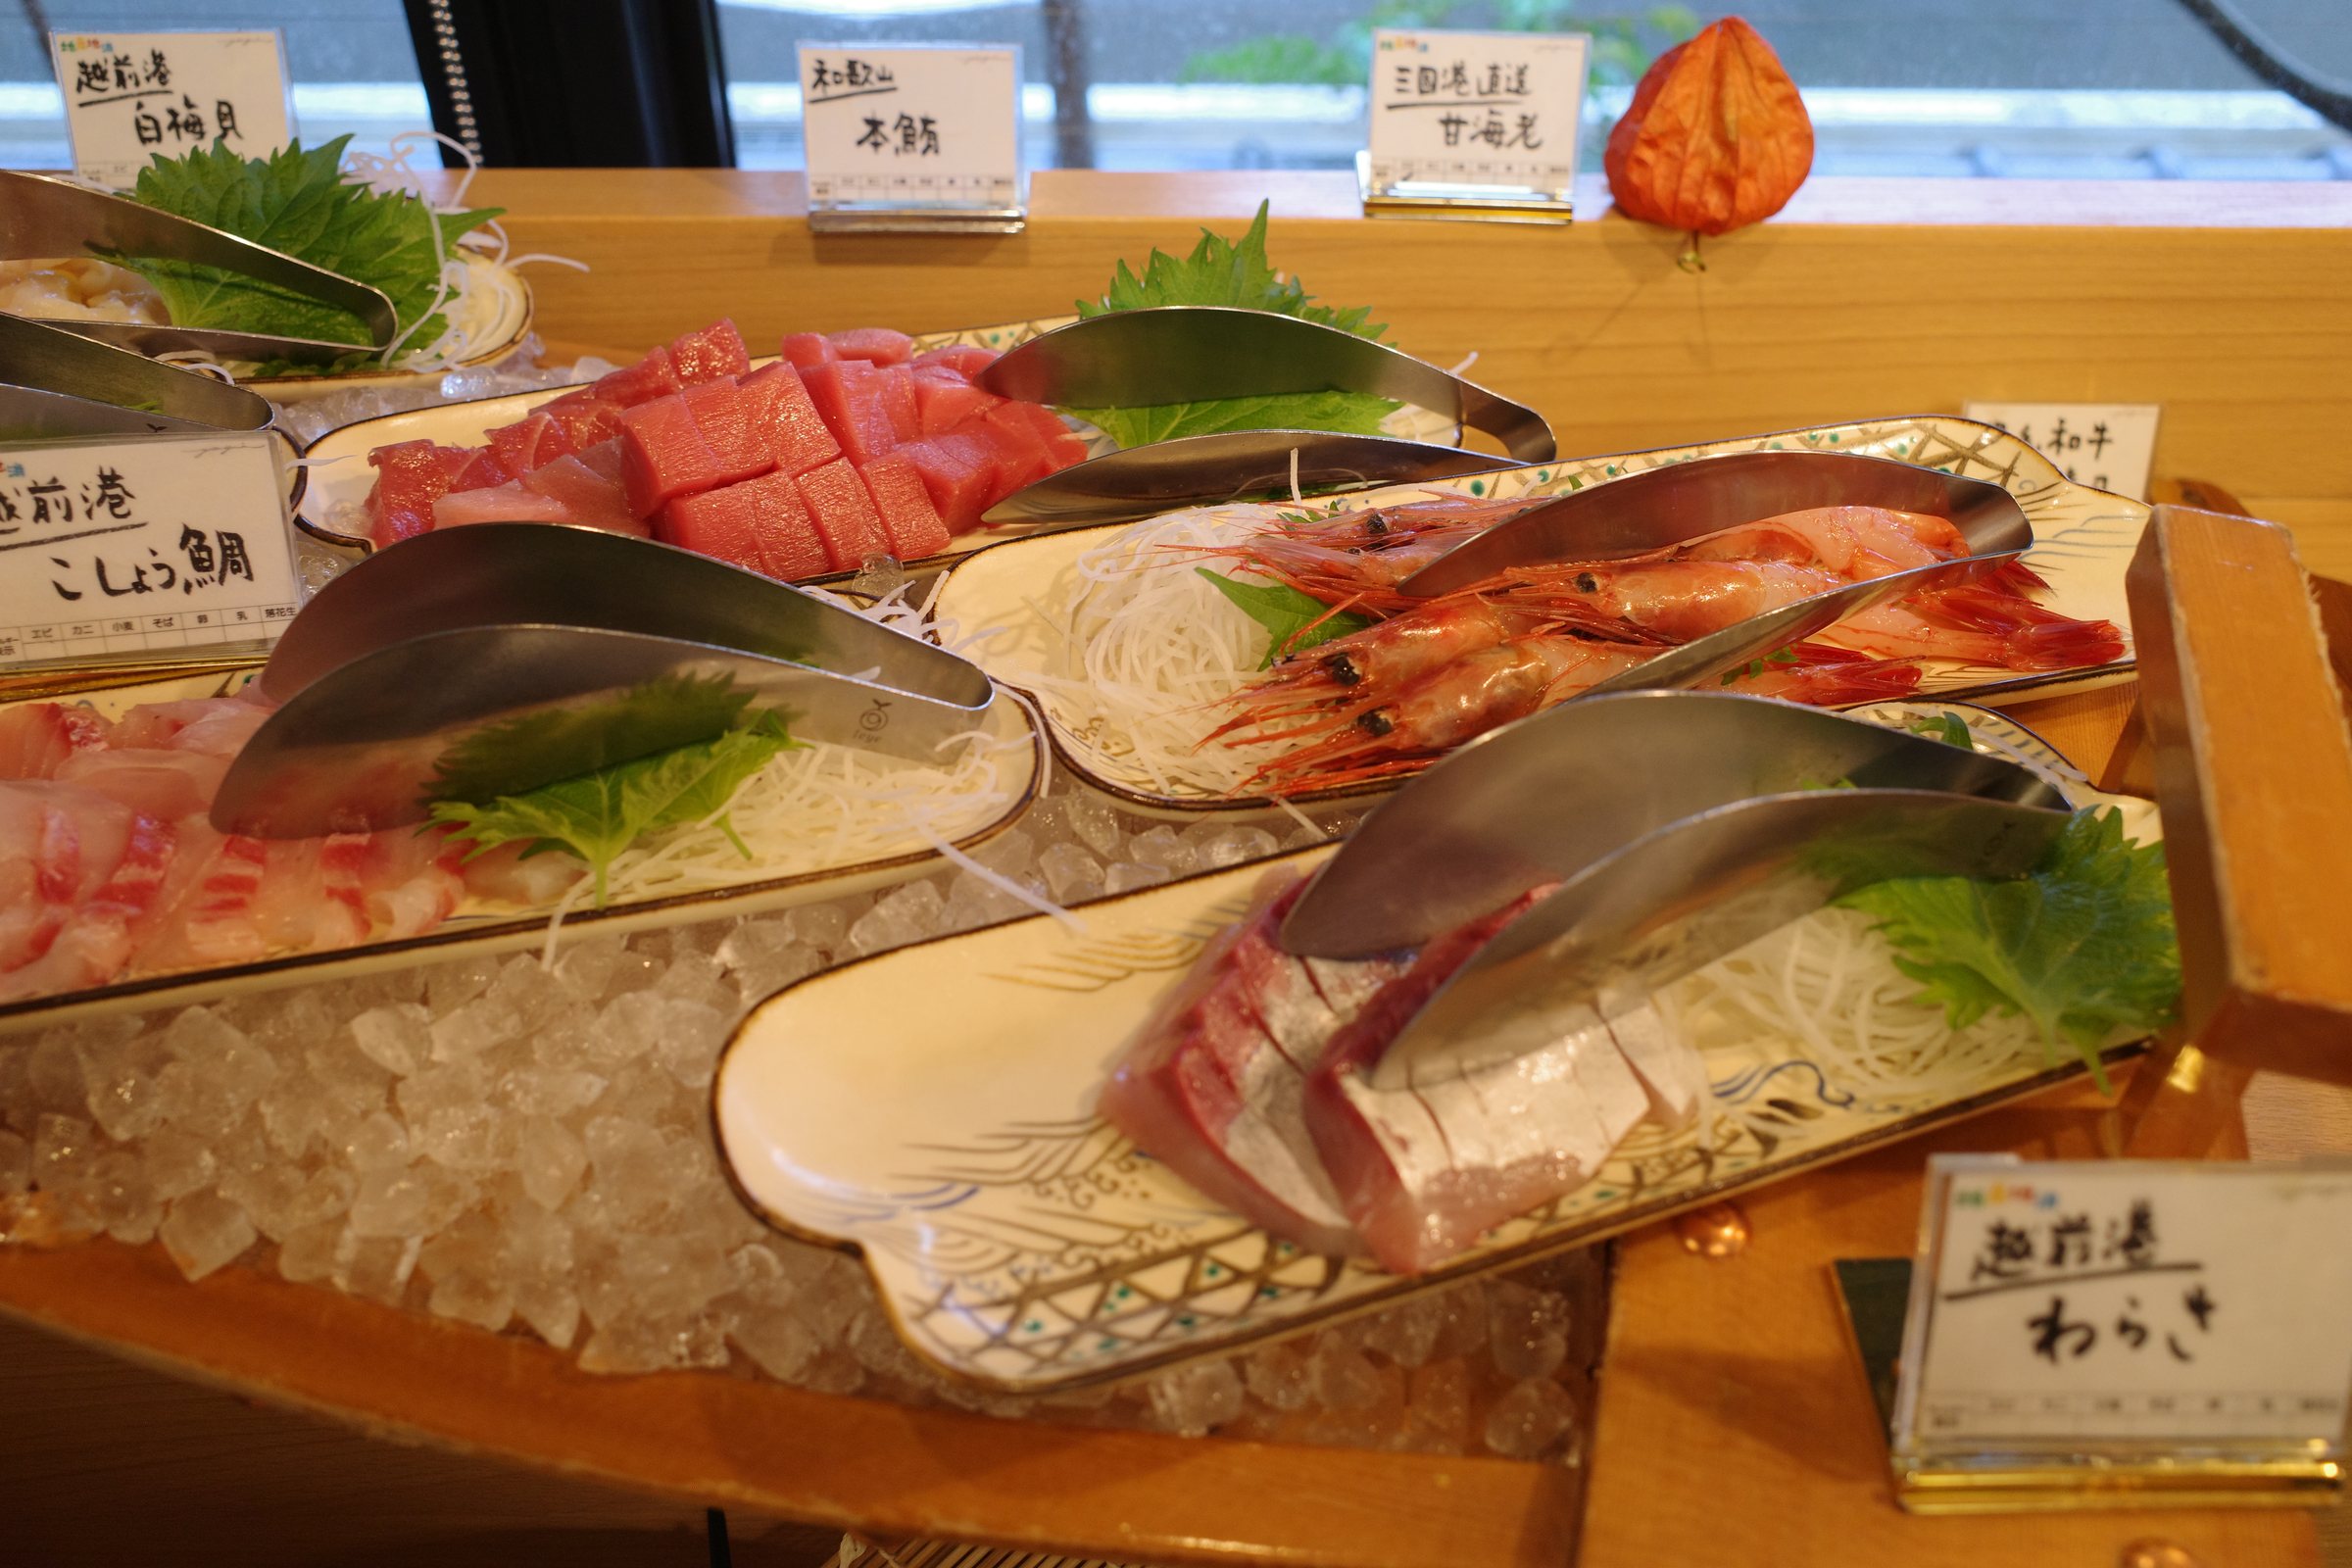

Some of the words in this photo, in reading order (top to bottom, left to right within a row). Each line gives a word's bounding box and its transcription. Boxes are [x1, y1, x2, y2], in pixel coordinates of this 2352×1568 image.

[76, 48, 171, 93] 越前港
[812, 59, 894, 92] 和歌山
[1396, 60, 1532, 96] 三国港直送
[856, 111, 940, 156] 本鮪
[1439, 109, 1544, 150] 甘海老
[51, 523, 255, 601] こしょう鯛
[31, 627, 53, 639] エビ
[72, 624, 94, 636] カニ
[112, 620, 134, 632] 小麦
[152, 616, 174, 628] そば
[1970, 1197, 2159, 1282] 越前港
